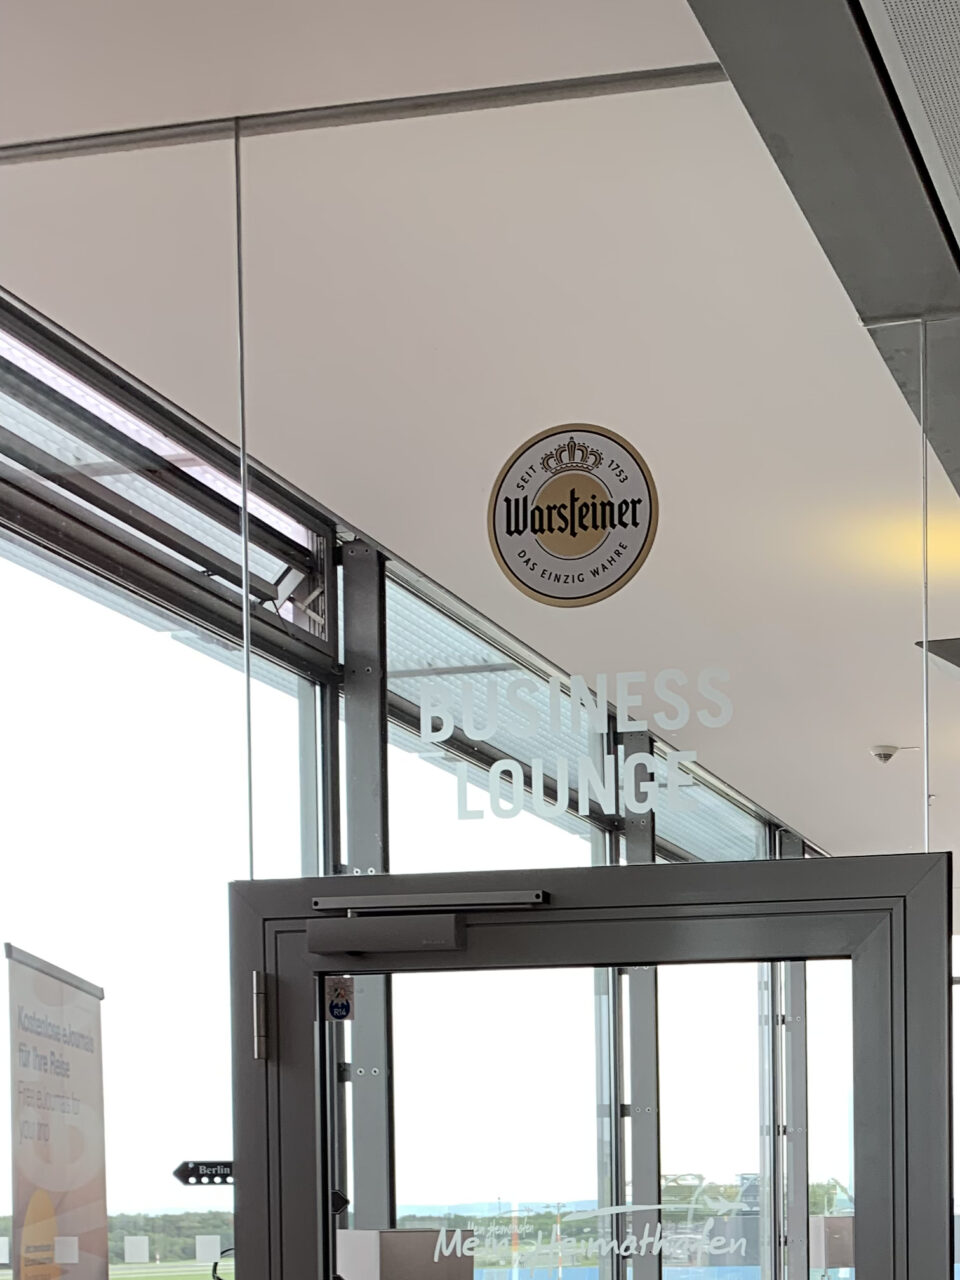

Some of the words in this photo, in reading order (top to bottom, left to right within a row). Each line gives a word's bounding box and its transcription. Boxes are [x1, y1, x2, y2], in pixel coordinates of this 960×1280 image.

[516, 464, 537, 491] SEIT
[607, 459, 629, 484] 1753
[503, 487, 643, 538] Warsteiner
[517, 550, 538, 571] DAS
[540, 569, 585, 584] EINZIG
[590, 542, 628, 578] WAHRE
[419, 667, 734, 744] BUSINESS
[456, 750, 698, 821] LOUNGE
[198, 1165, 231, 1175] Berlin
[433, 1227, 511, 1263] Mein
[515, 1217, 747, 1279] Heimathafen
